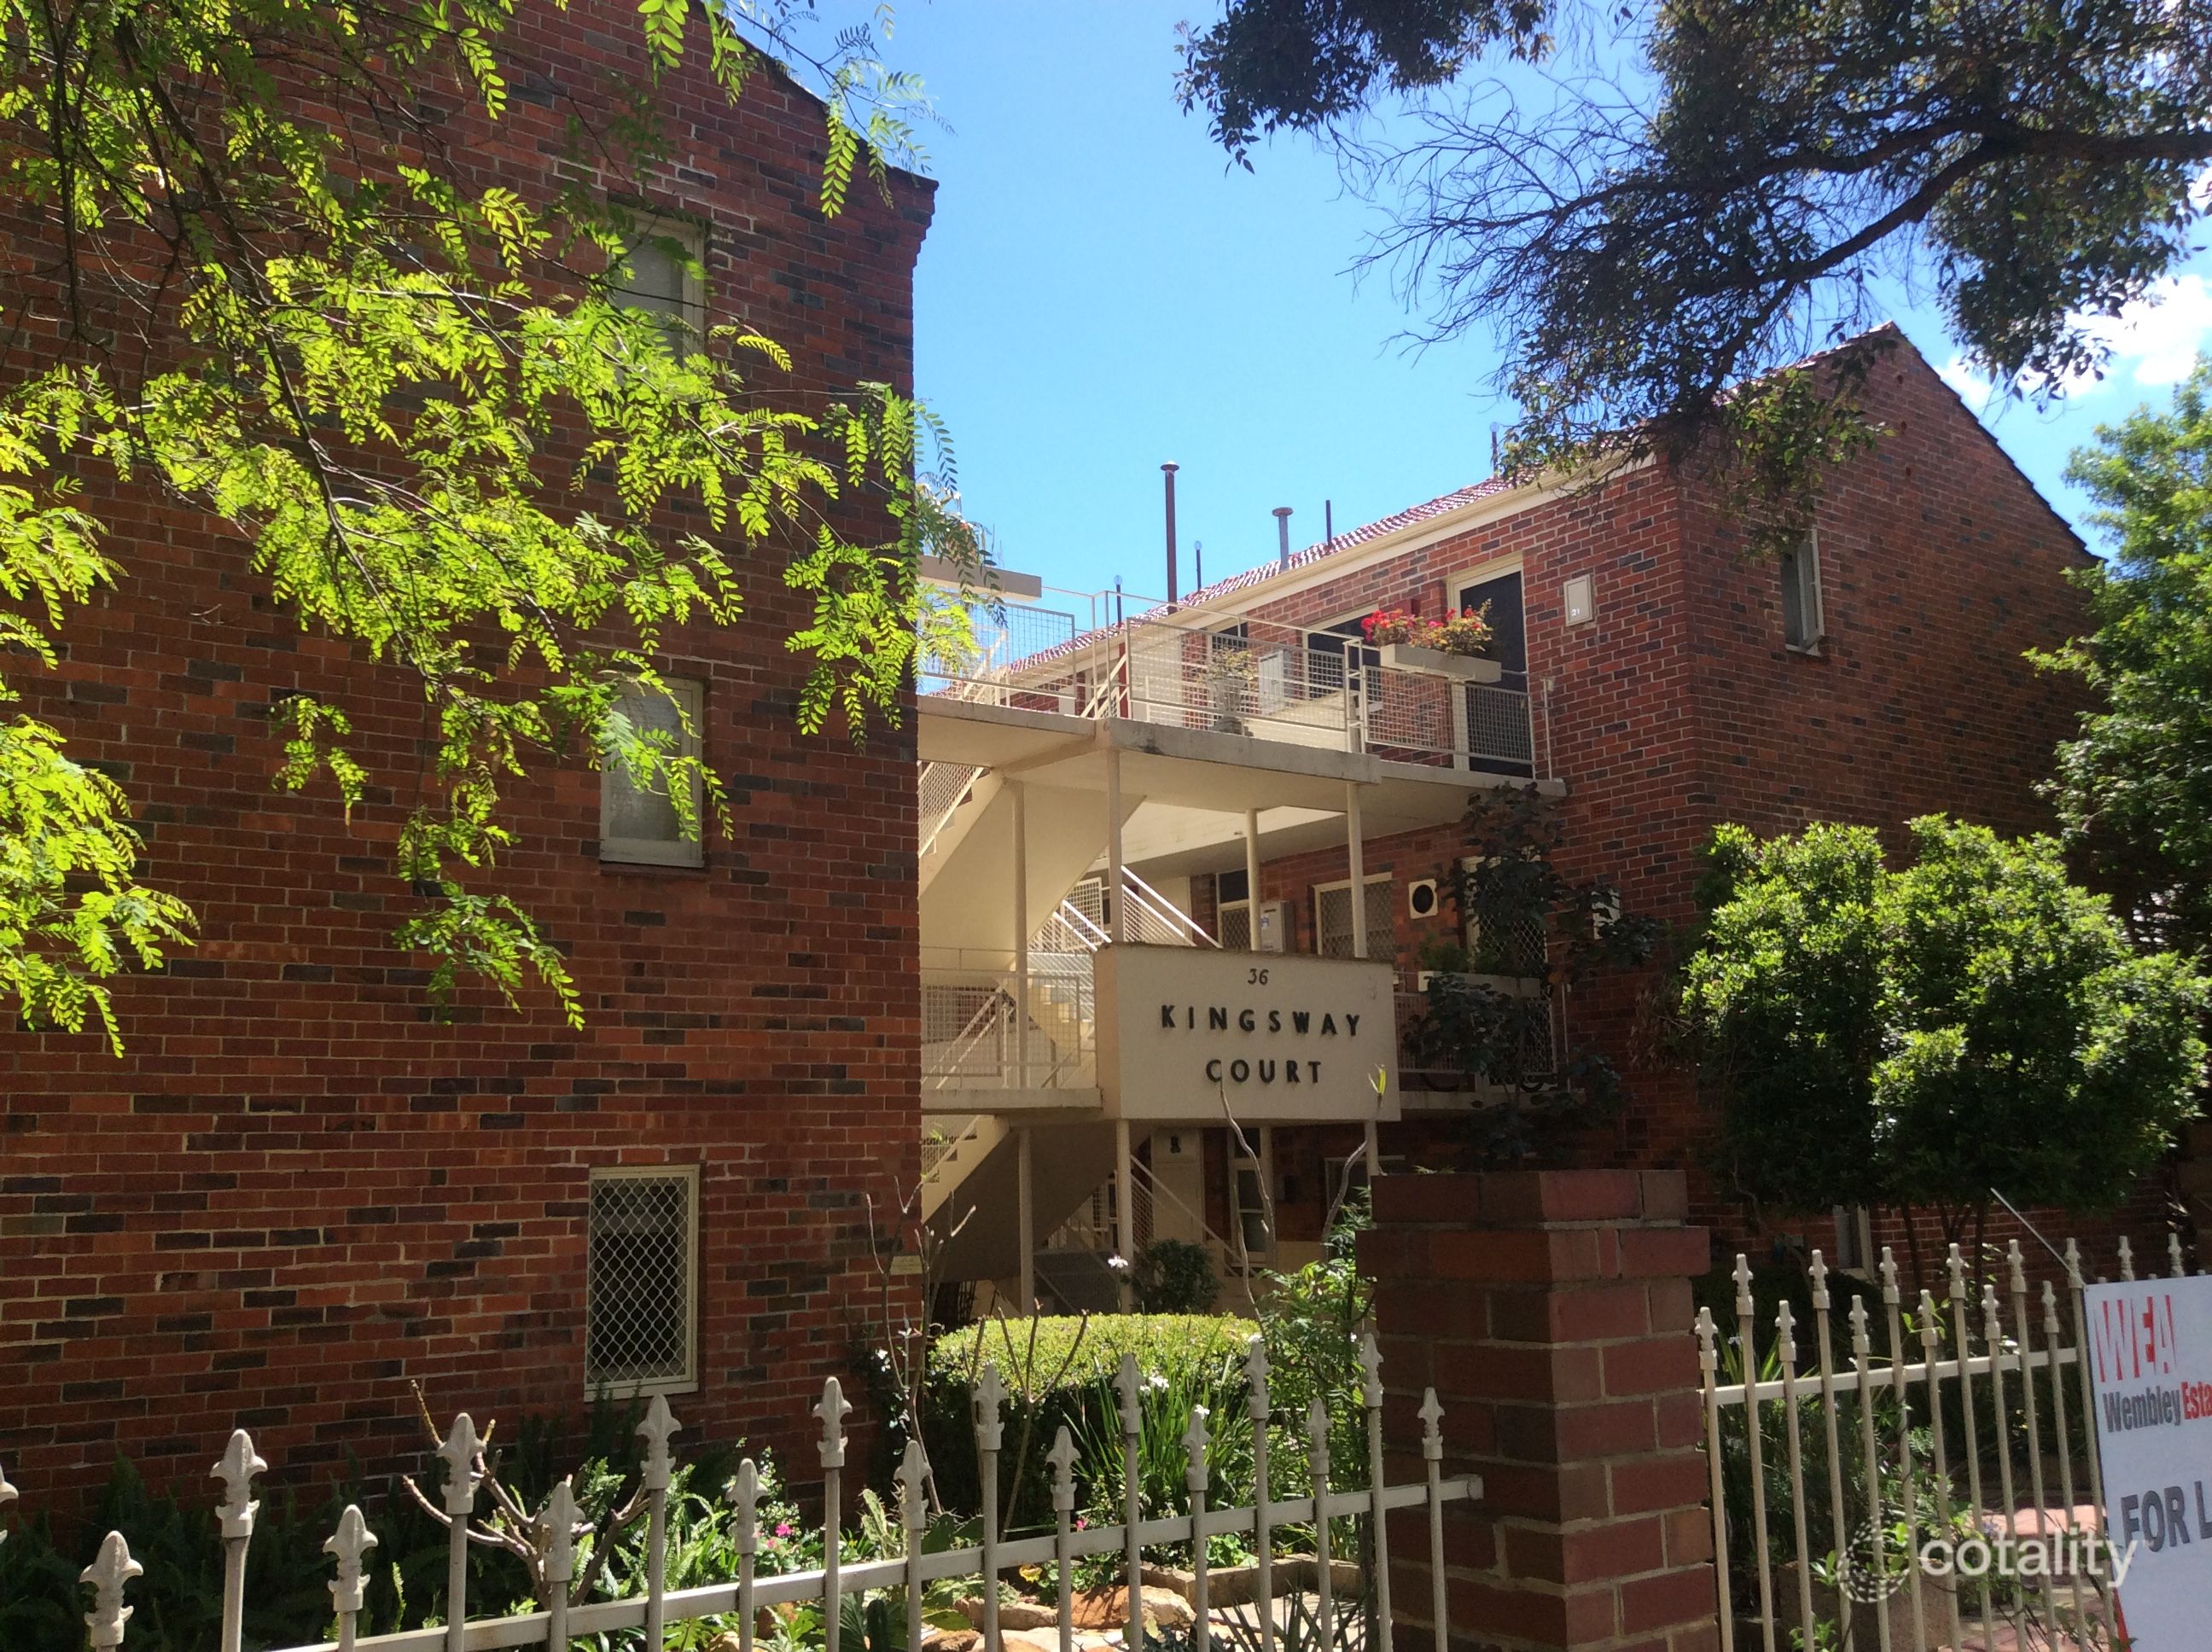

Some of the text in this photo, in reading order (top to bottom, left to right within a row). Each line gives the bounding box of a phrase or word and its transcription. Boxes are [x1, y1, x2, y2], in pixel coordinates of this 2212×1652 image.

[1248, 969, 1269, 985] 36
[1161, 1005, 1359, 1036] KINGSWAY
[1206, 1060, 1321, 1084] COURT
[2121, 1486, 2191, 1552] FOR
